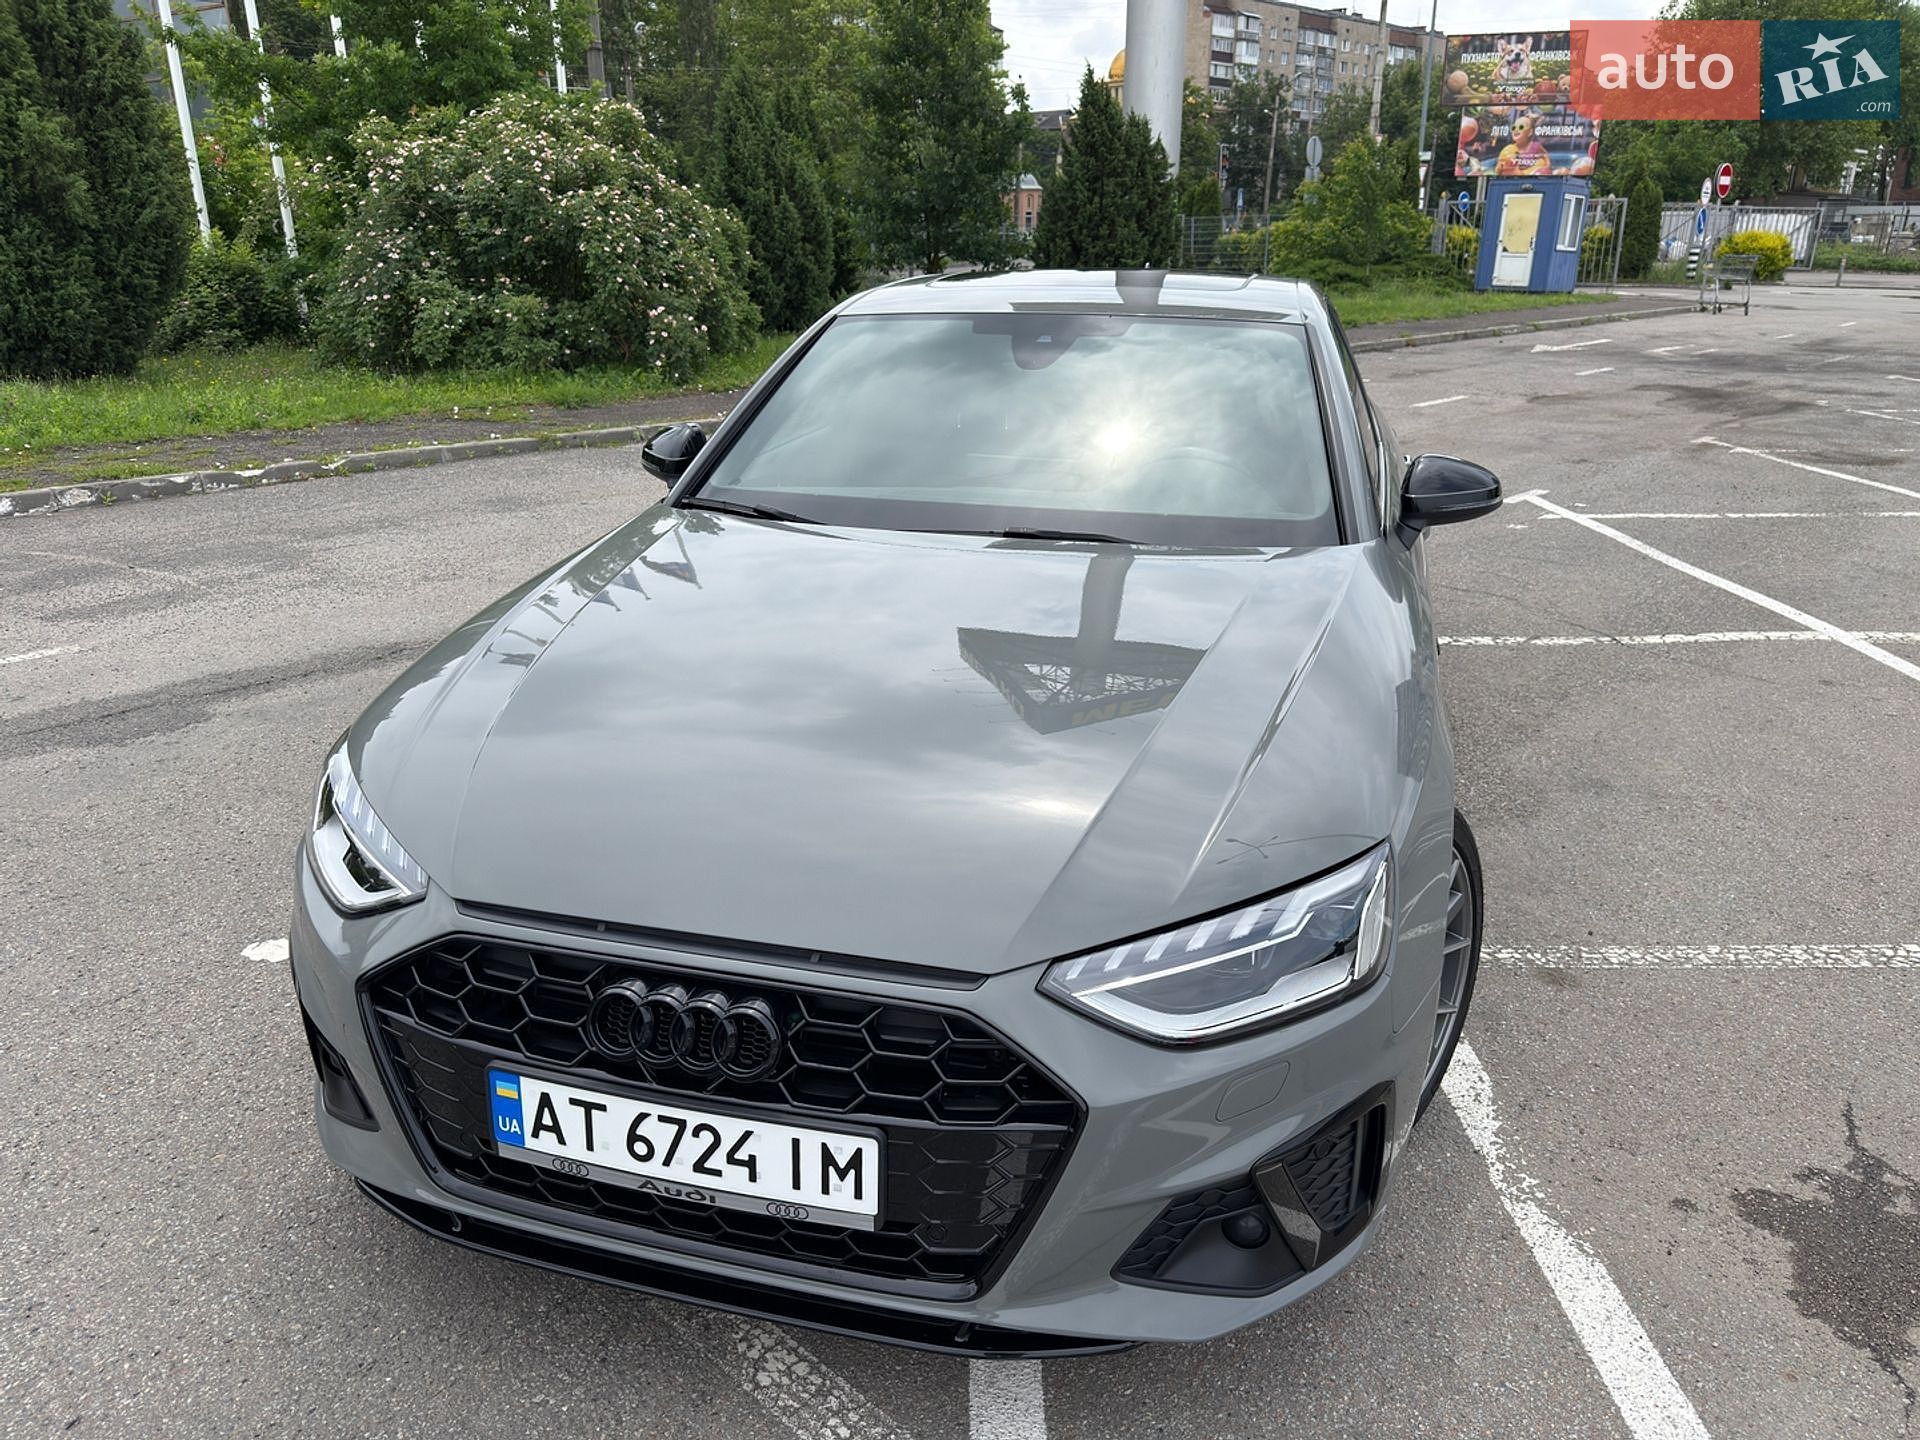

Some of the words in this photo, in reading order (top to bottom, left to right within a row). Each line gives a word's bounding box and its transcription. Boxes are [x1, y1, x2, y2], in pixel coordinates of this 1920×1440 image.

[498, 1115, 521, 1135] UA
[530, 1091, 607, 1152] AT
[626, 1112, 757, 1183] 6724
[791, 1137, 863, 1200] IM
